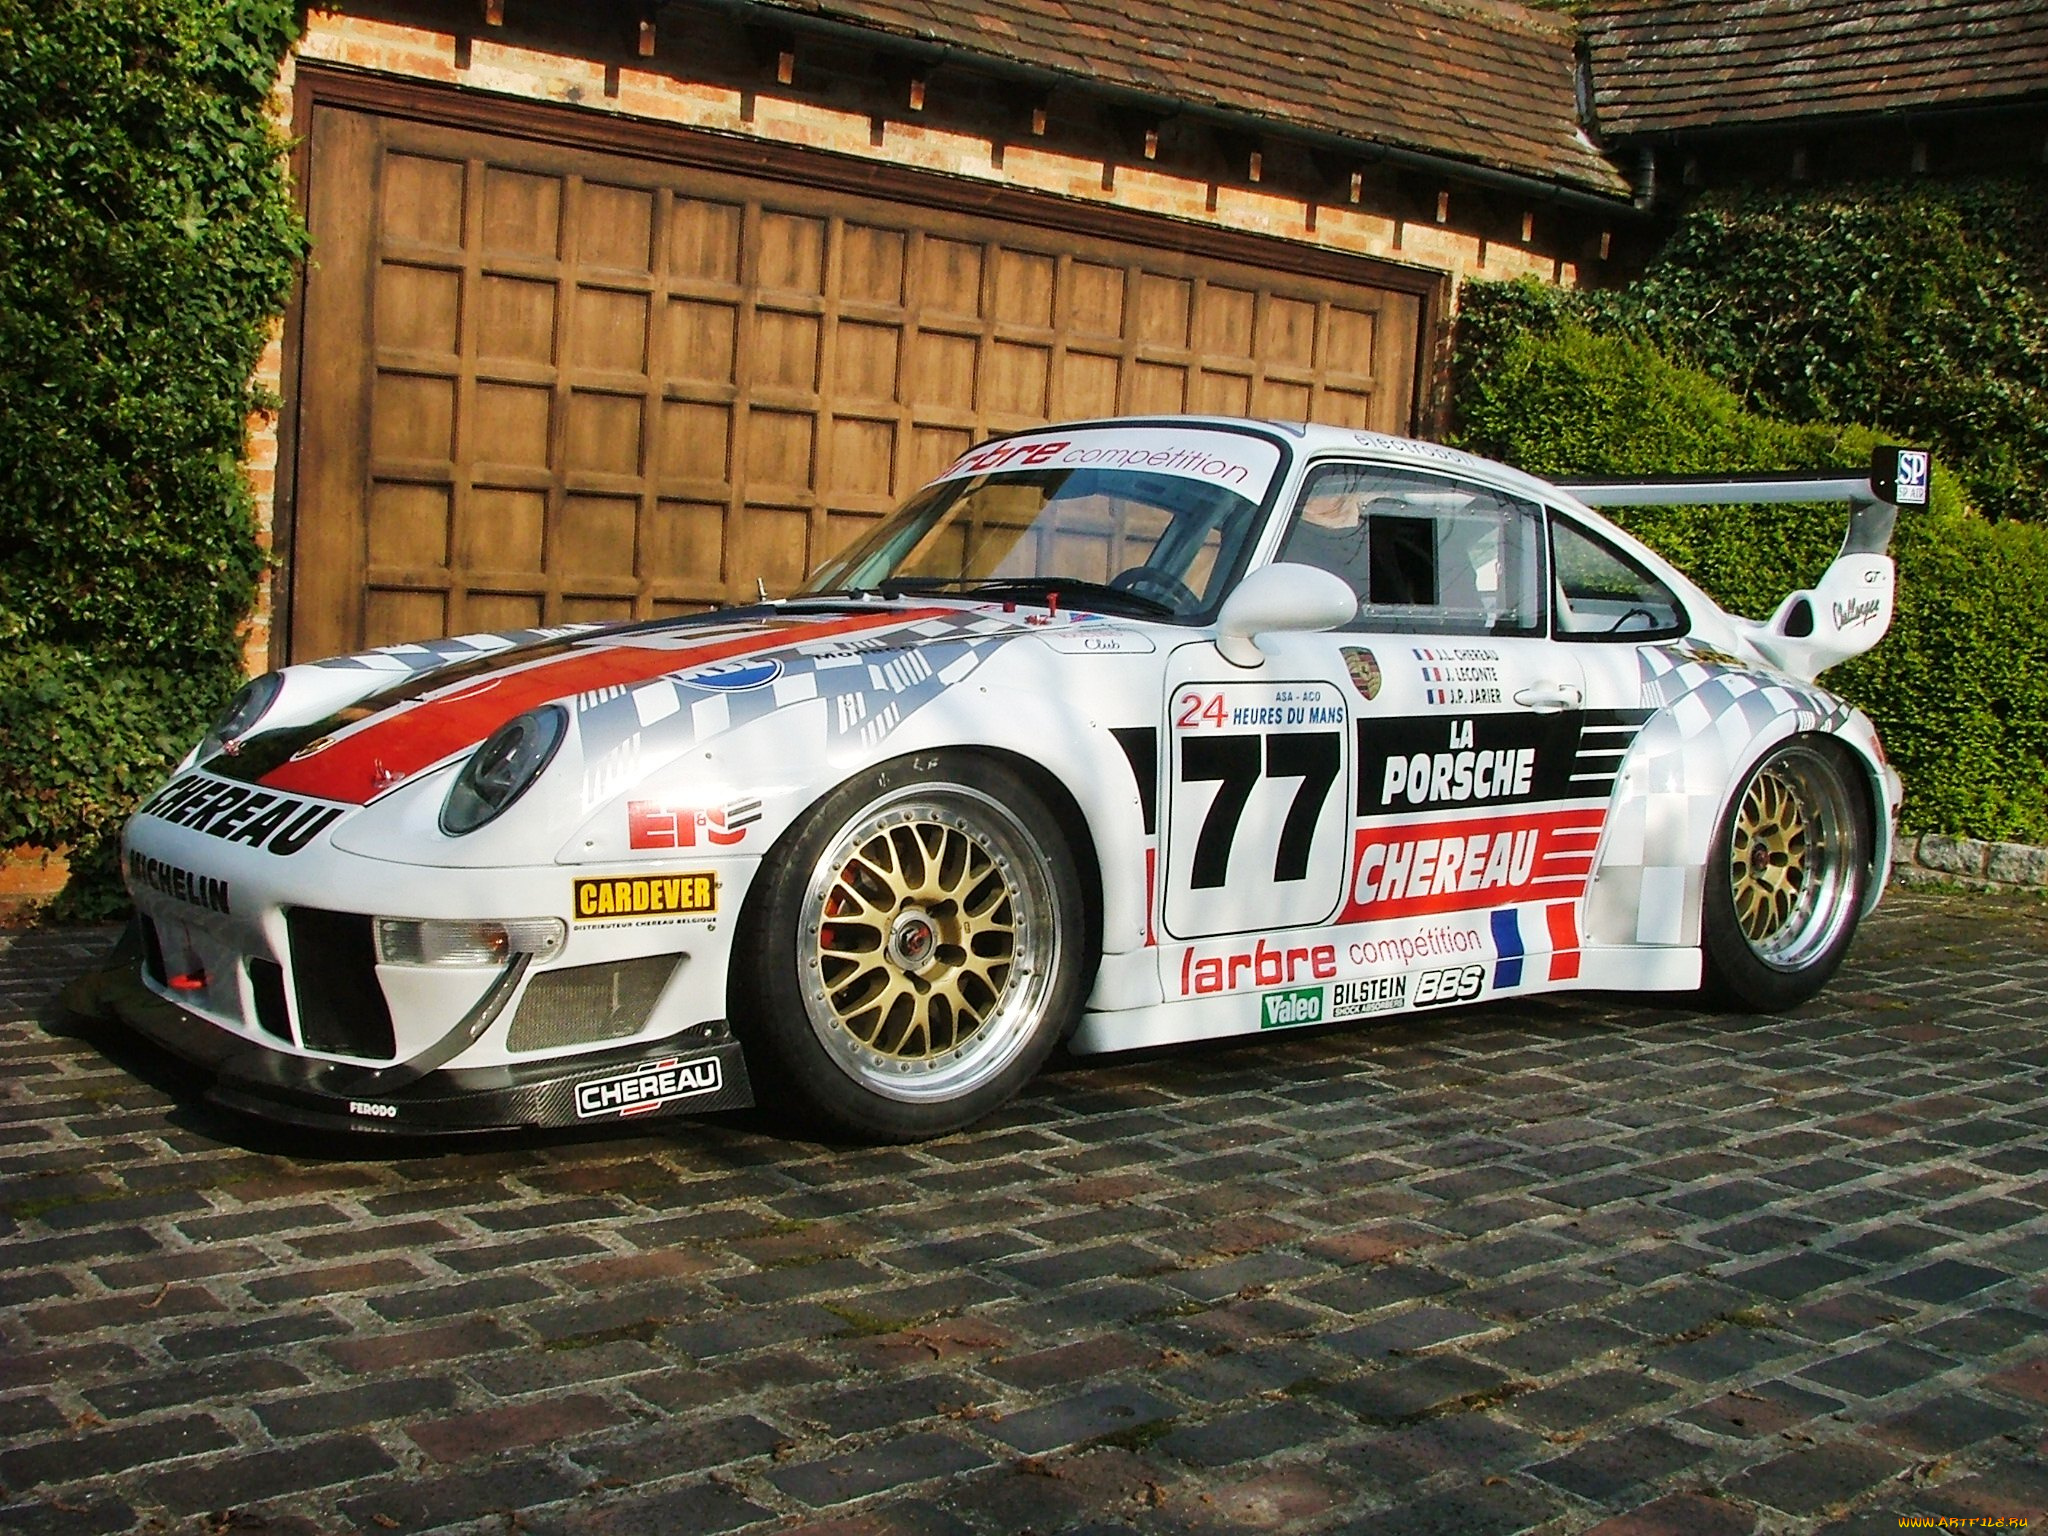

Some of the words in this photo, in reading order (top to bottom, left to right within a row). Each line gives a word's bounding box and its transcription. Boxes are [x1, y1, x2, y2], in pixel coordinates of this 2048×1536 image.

[1062, 446, 1249, 484] compétition
[1899, 453, 1925, 485] SP
[1864, 570, 1881, 583] GT
[1084, 638, 1121, 650] Club
[1454, 649, 1499, 661] CHEREAU
[1455, 667, 1498, 682] LECONTE
[1176, 691, 1229, 729] 24
[1233, 707, 1282, 725] HEURES
[1286, 707, 1305, 724] DU
[1309, 706, 1343, 724] MANS
[1275, 691, 1293, 702] ASA
[1302, 691, 1321, 702] ACO
[1450, 689, 1468, 704] J.P.
[1470, 689, 1502, 704] JARIER
[1449, 719, 1474, 750] LA
[1381, 747, 1536, 806] PORSCHE
[141, 774, 345, 857] CHEREAU
[1181, 732, 1341, 890] 77
[1354, 828, 1539, 907] CHEREAU
[580, 876, 711, 915] CARDEVER
[573, 921, 633, 931] DISTRIBUTEUR
[635, 919, 674, 928] CHEREAU
[676, 917, 717, 925] BELGIQUE
[1181, 939, 1337, 995] larbre
[1349, 926, 1483, 970] compétition
[1333, 976, 1407, 1006] BILSTEIN
[1413, 964, 1486, 1008] BBS
[1265, 992, 1321, 1025] Valeo
[1334, 1004, 1361, 1017] SHOCK
[581, 1063, 716, 1110] CHEREAU
[349, 1101, 397, 1118] FERODO
